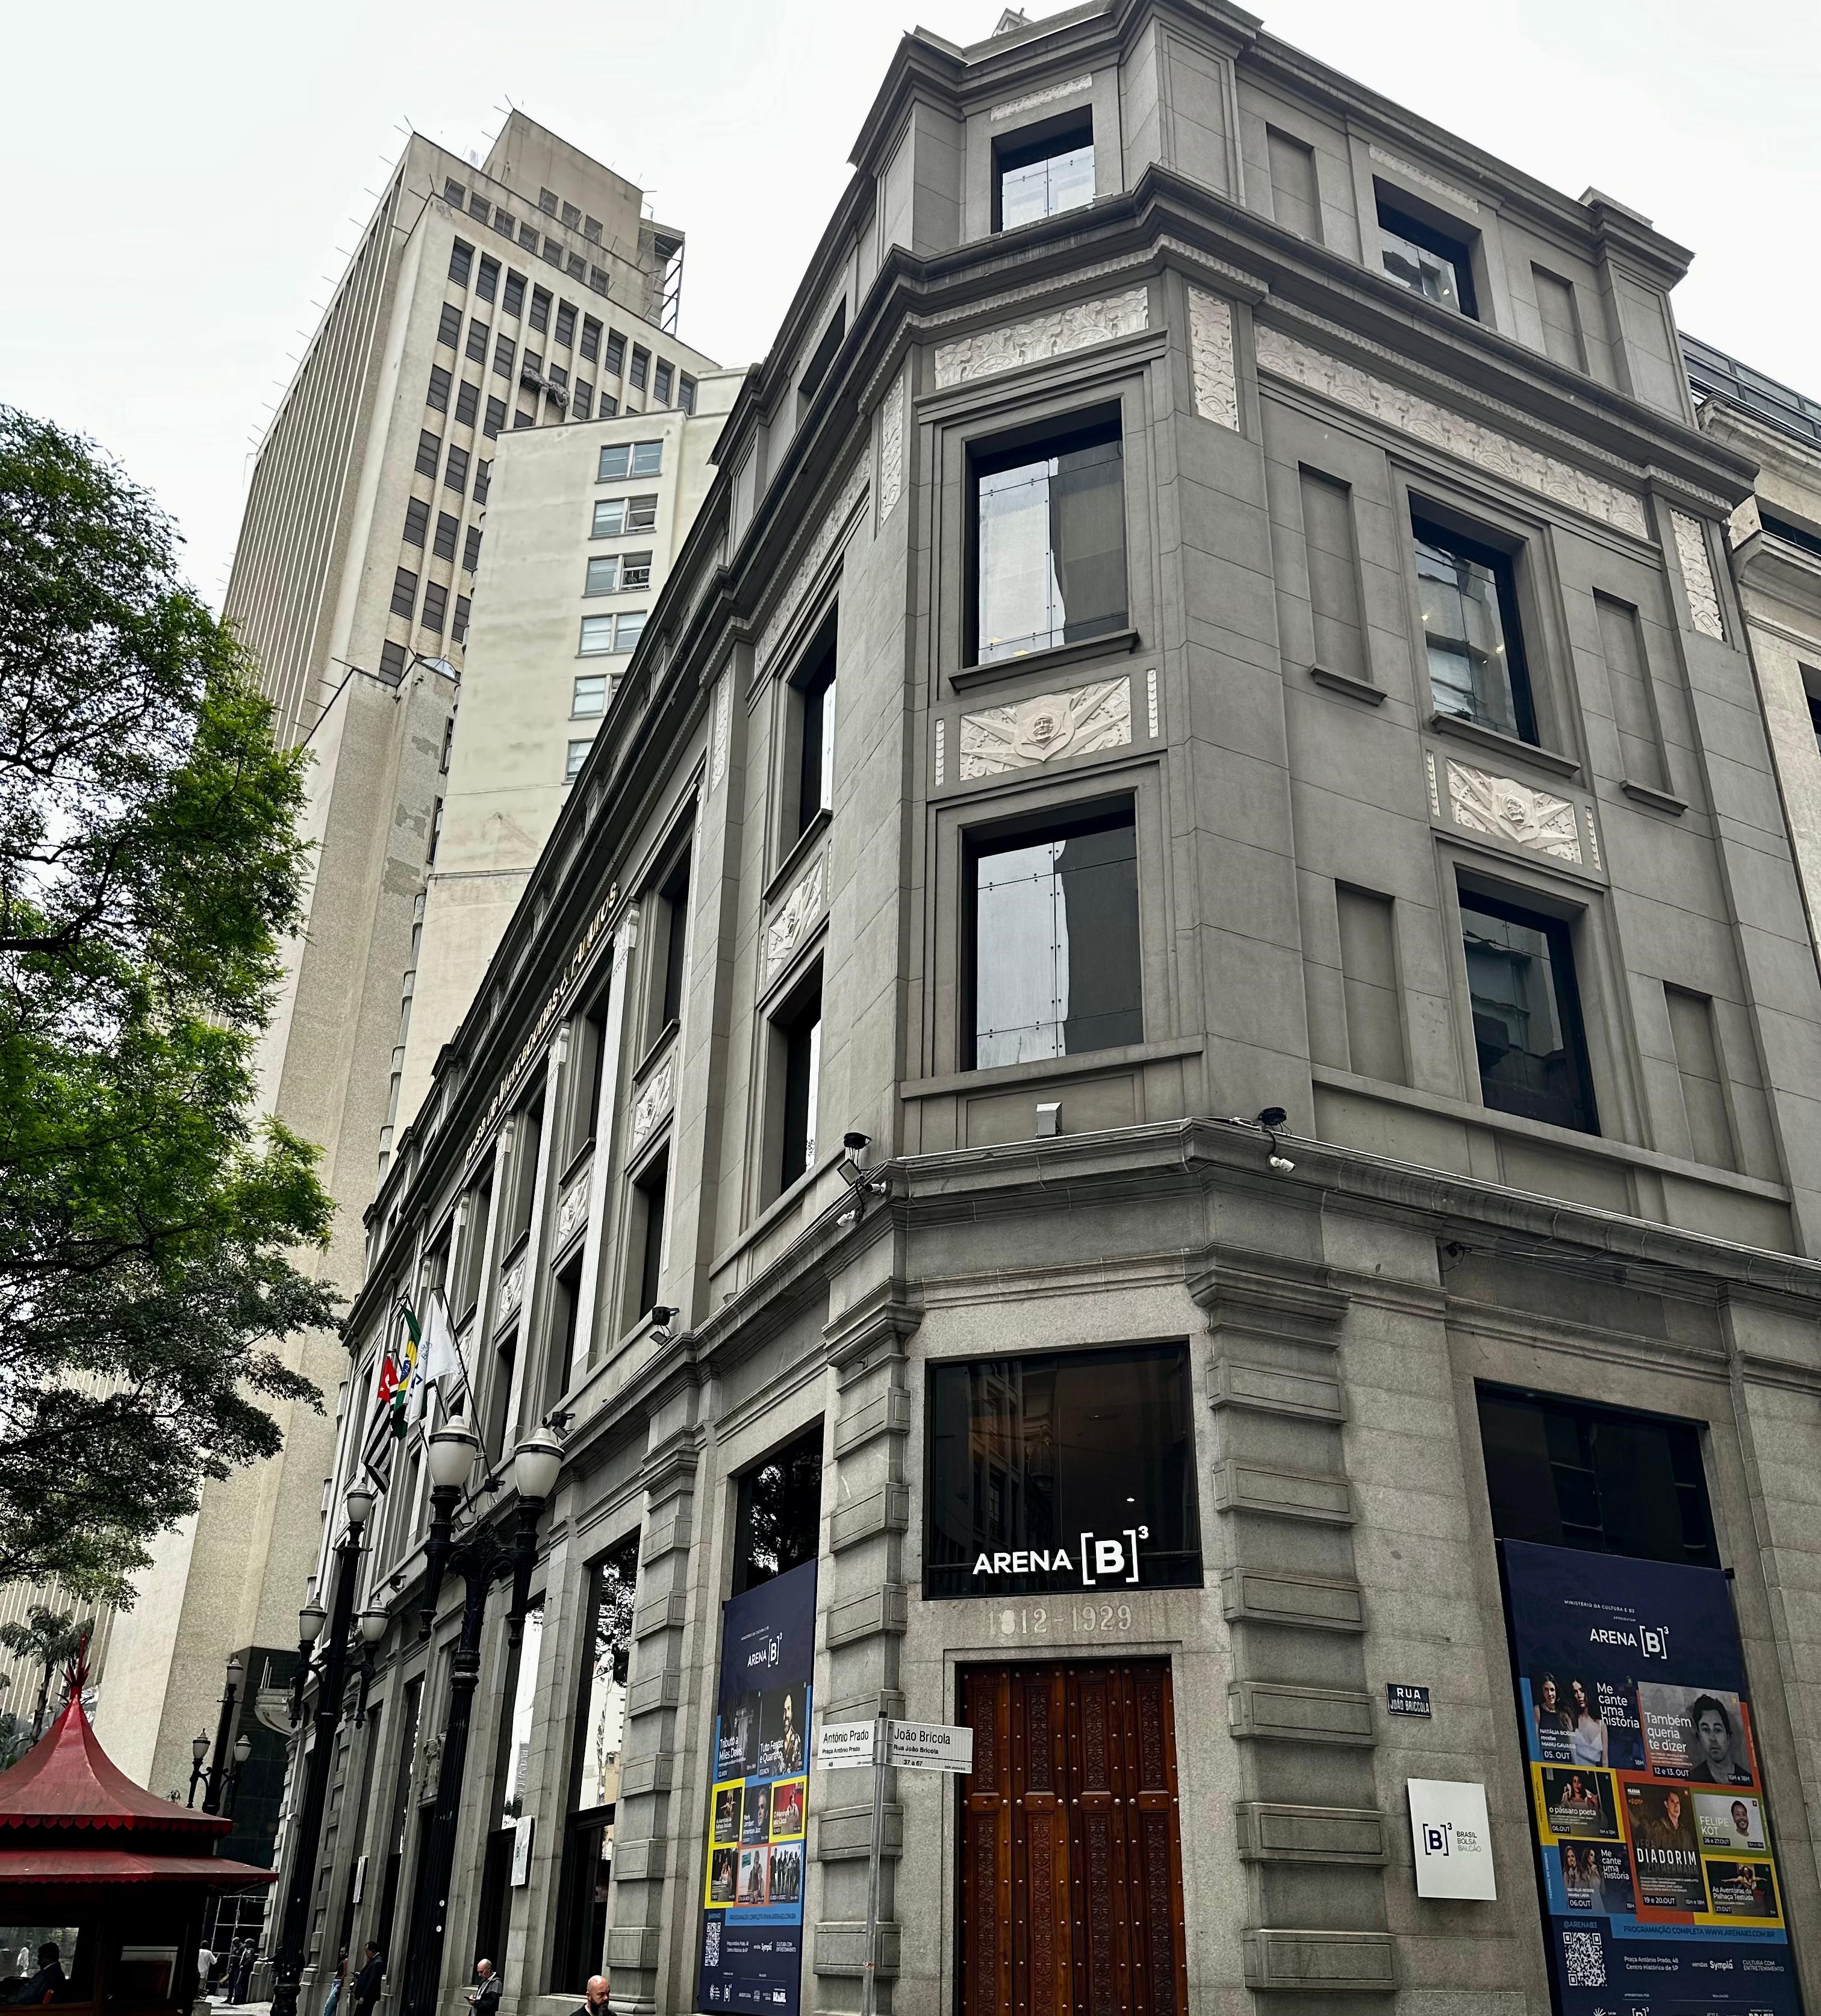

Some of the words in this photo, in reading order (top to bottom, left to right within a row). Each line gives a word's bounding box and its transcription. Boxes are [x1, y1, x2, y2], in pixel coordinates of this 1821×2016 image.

[973, 1549, 1074, 1575] ARENA
[1564, 1599, 1593, 1608] MINISTÉRIO
[1590, 1628, 1638, 1647] ARENA
[747, 1649, 767, 1667] ARENA
[1397, 1687, 1421, 1699] RUA
[1596, 1682, 1613, 1694] Me
[1390, 1698, 1404, 1710] JOÃO
[1405, 1700, 1430, 1713] BRICCOLA
[1598, 1695, 1628, 1706] cante
[1599, 1705, 1624, 1717] uma
[1601, 1713, 1640, 1729] história
[1644, 1711, 1692, 1728] Também
[823, 1732, 848, 1744] Antônio
[850, 1729, 869, 1741] Prado
[894, 1728, 917, 1741] João
[1647, 1727, 1680, 1740] queria
[1649, 1740, 1660, 1750] te
[1661, 1739, 1687, 1752] dizer
[1554, 1806, 1578, 1815] pássaro
[1699, 1816, 1730, 1828] FELIPE
[1701, 1825, 1719, 1836] KOT
[1636, 1839, 1655, 1849] VERA
[1637, 1847, 1697, 1865] DIADORIM
[1604, 1871, 1630, 1880] história
[1563, 1920, 1598, 1929] @ARENAB3
[1623, 1925, 1672, 1935] PROGRAMAÇÃO
[1672, 1927, 1705, 1935] COMPLETA
[1705, 1928, 1776, 1938] WWW.ARENAB3.COM.BR
